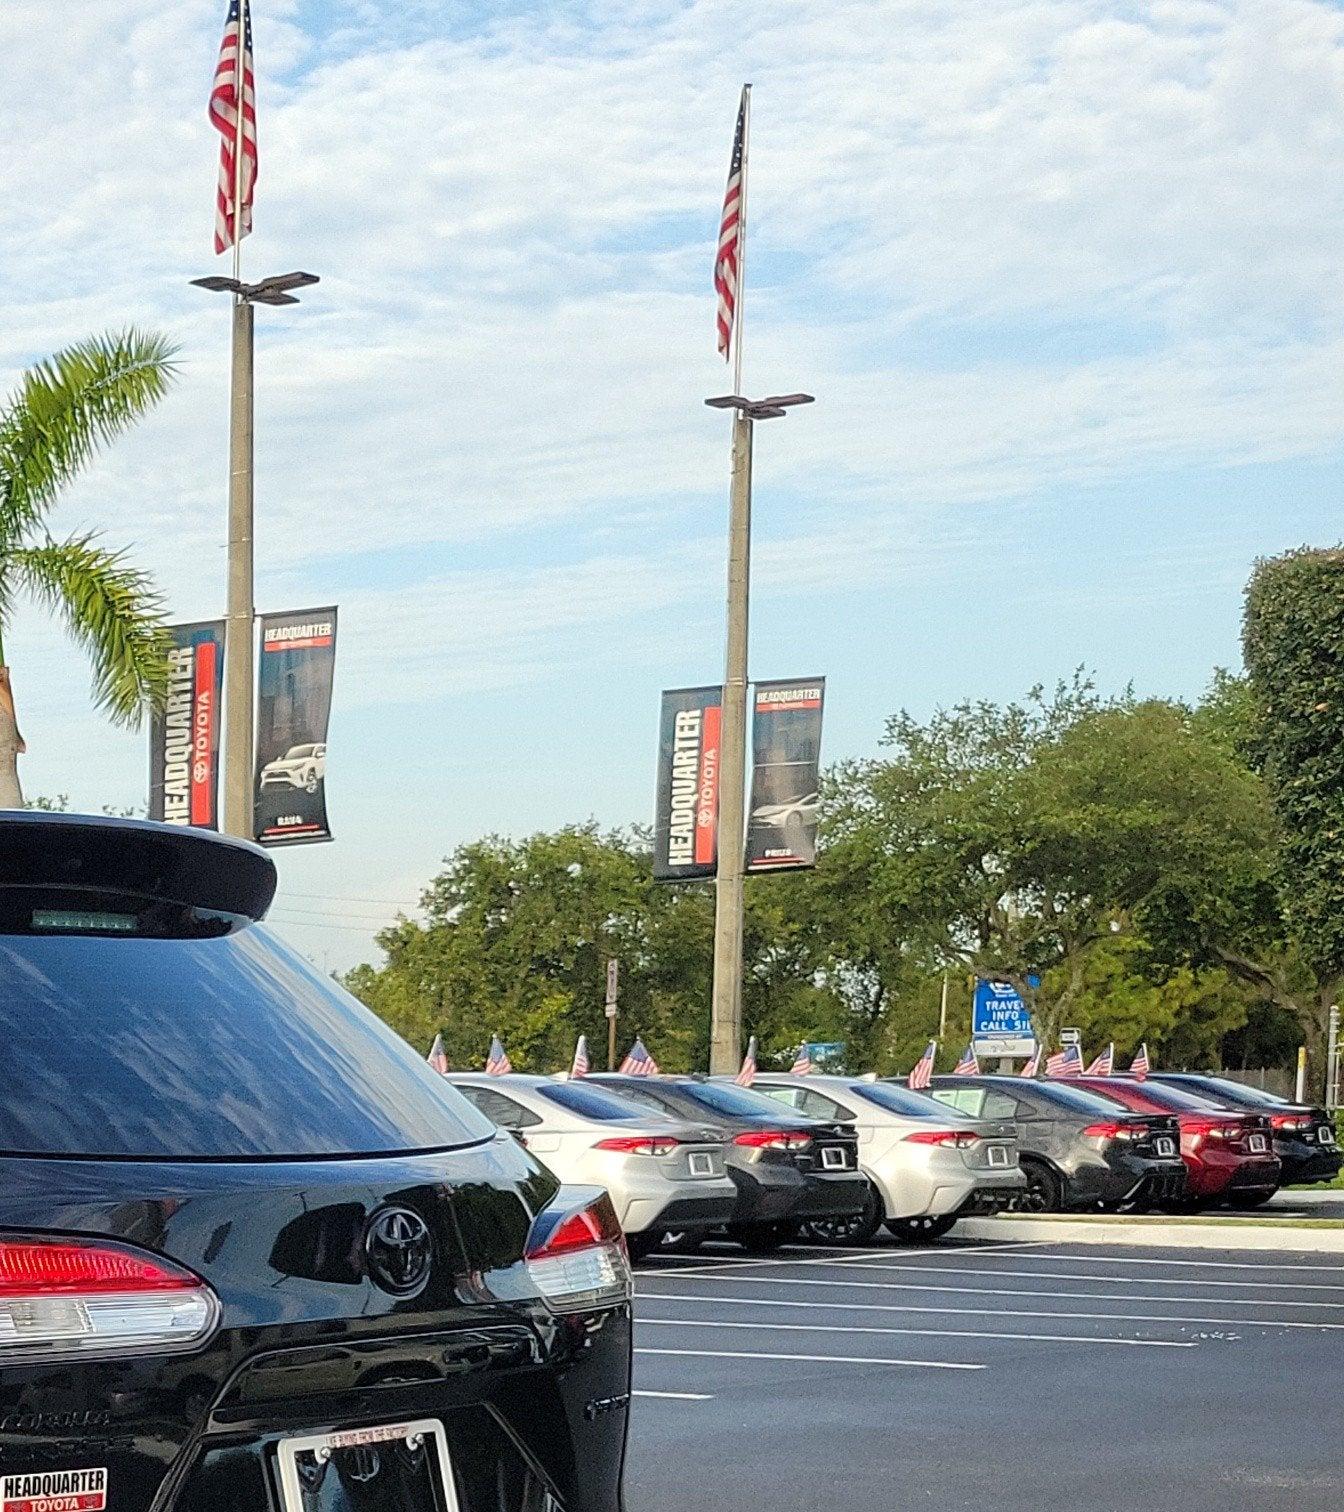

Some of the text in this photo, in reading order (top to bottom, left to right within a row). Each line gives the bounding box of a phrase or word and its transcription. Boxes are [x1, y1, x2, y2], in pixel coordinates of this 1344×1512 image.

[265, 623, 331, 642] HEADQUARTER
[756, 688, 821, 704] HEADQUARTER
[196, 691, 210, 761] TOYOTA
[163, 646, 194, 826] HEADQUARTER
[701, 748, 717, 806] TOYOTA
[668, 708, 701, 866] HEADQUARTER
[764, 848, 792, 858] PRIUS
[993, 1010, 1019, 1021] INFO
[980, 1021, 1007, 1031] CALL
[4, 1470, 104, 1498] HEADQUARTER
[30, 1498, 79, 1512] TOYOTA
